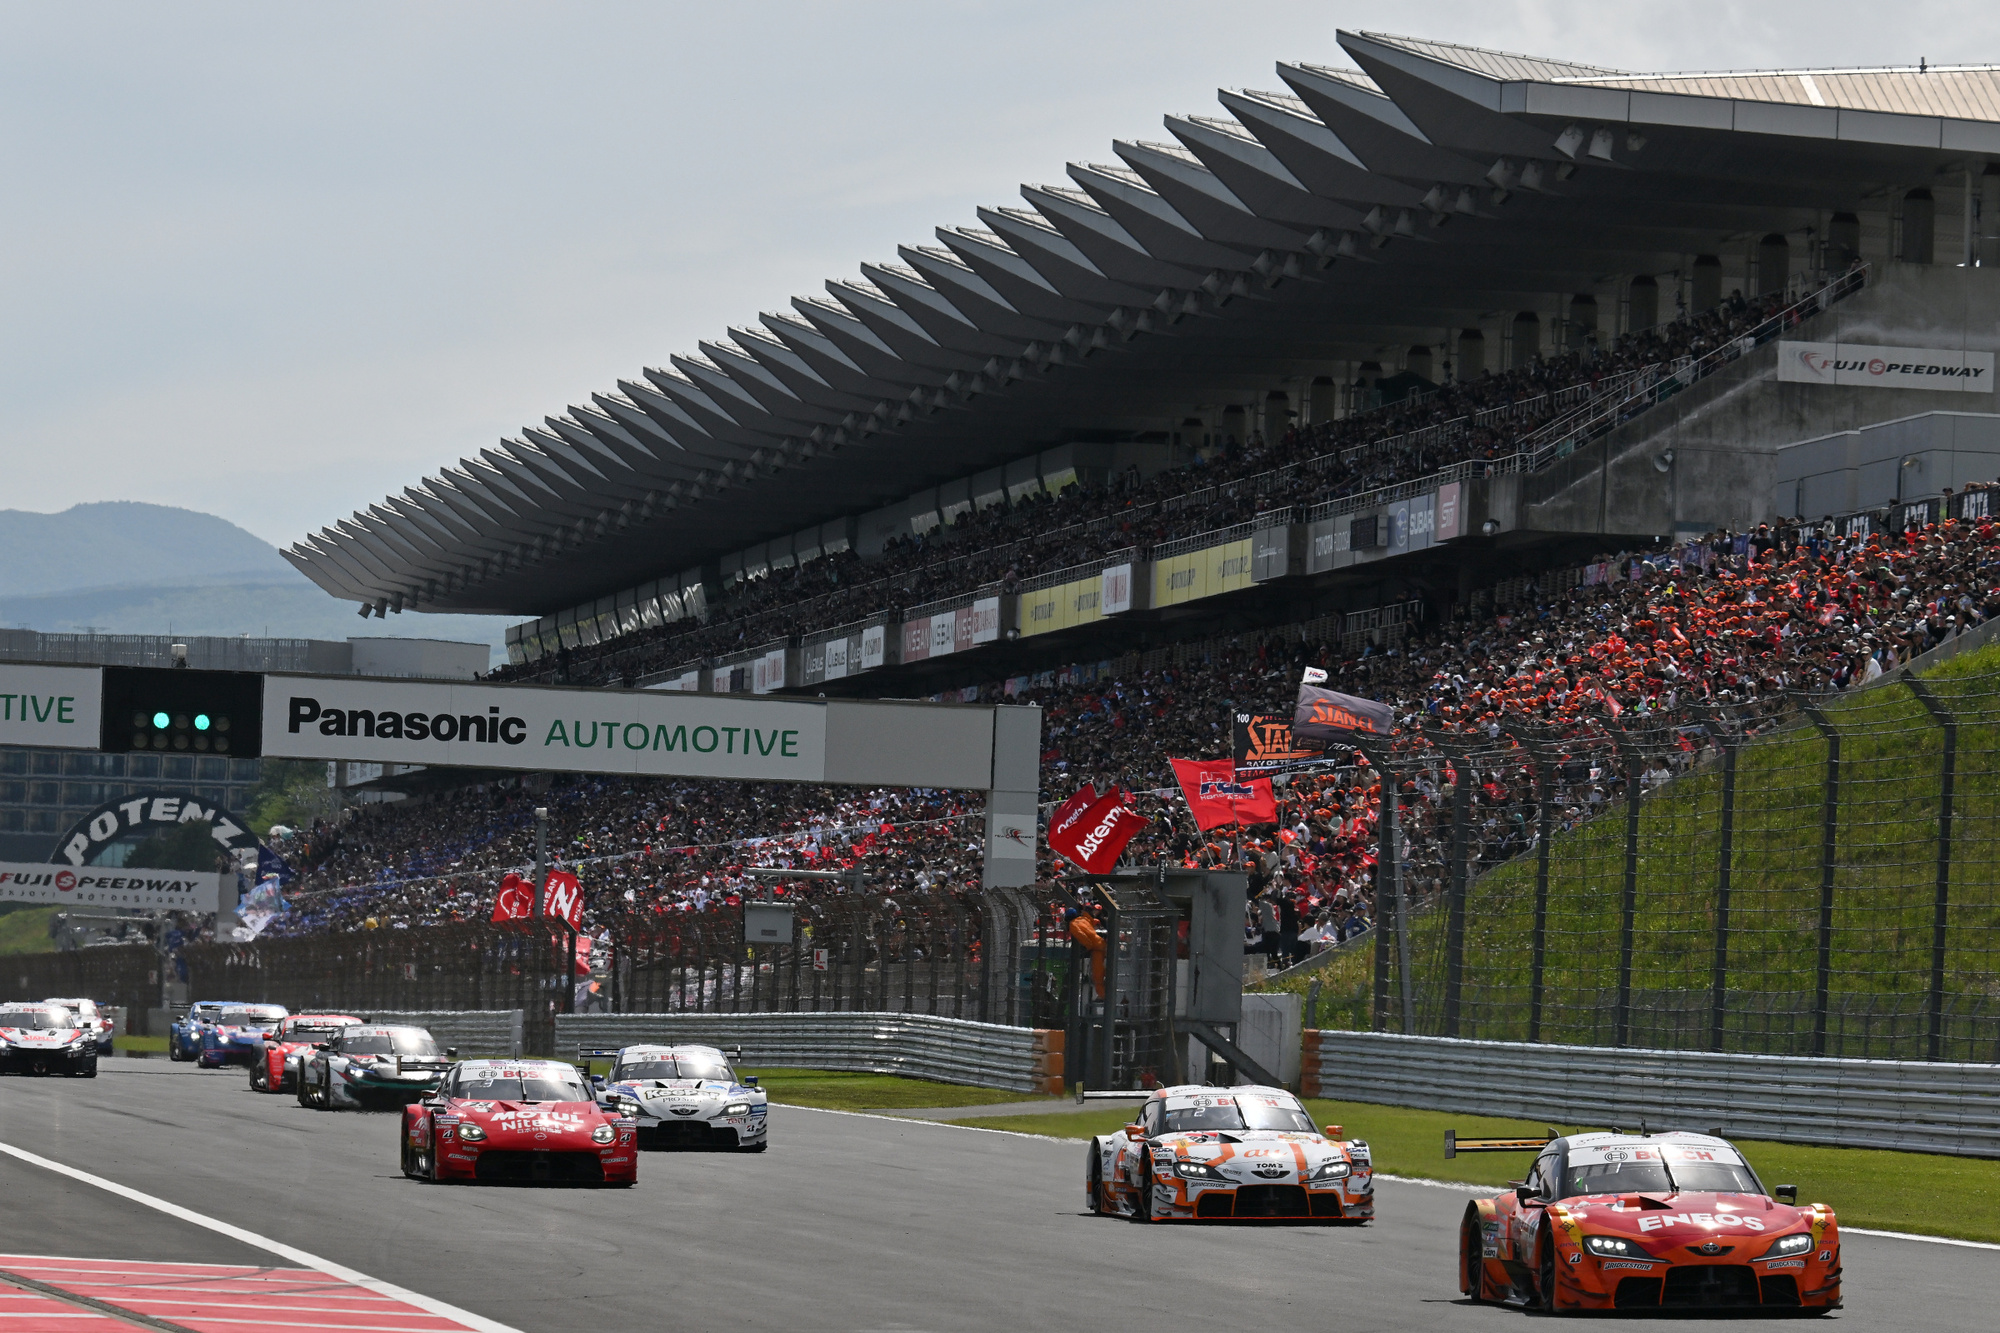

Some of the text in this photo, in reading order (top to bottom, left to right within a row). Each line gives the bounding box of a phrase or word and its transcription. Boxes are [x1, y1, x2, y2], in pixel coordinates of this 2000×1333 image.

[1821, 358, 1986, 378] FUJI SPEEDWAY
[906, 627, 930, 653] NISSAN
[931, 620, 955, 647] NISSAN
[1308, 671, 1325, 679] HRC
[0, 693, 75, 724] TIVE
[1236, 713, 1250, 724] 100
[1308, 698, 1377, 733] STANLEY
[288, 697, 801, 759] Panasonic AUTOMOTIVE
[55, 870, 200, 894] SPEEDWAY
[77, 892, 197, 905] MOTORSPORTS
[503, 1070, 564, 1080] BOS
[1217, 1098, 1279, 1107] BOCH
[490, 1111, 585, 1124] MOTUL
[1321, 1154, 1346, 1163] sport
[1635, 1150, 1715, 1161] BOCH
[1190, 1181, 1227, 1189] BRIDGESTONE
[1637, 1213, 1765, 1232] ENEOS
[1604, 1262, 1653, 1271] BRIDGESTONE
[1767, 1261, 1805, 1270] BRIDGESTONE
